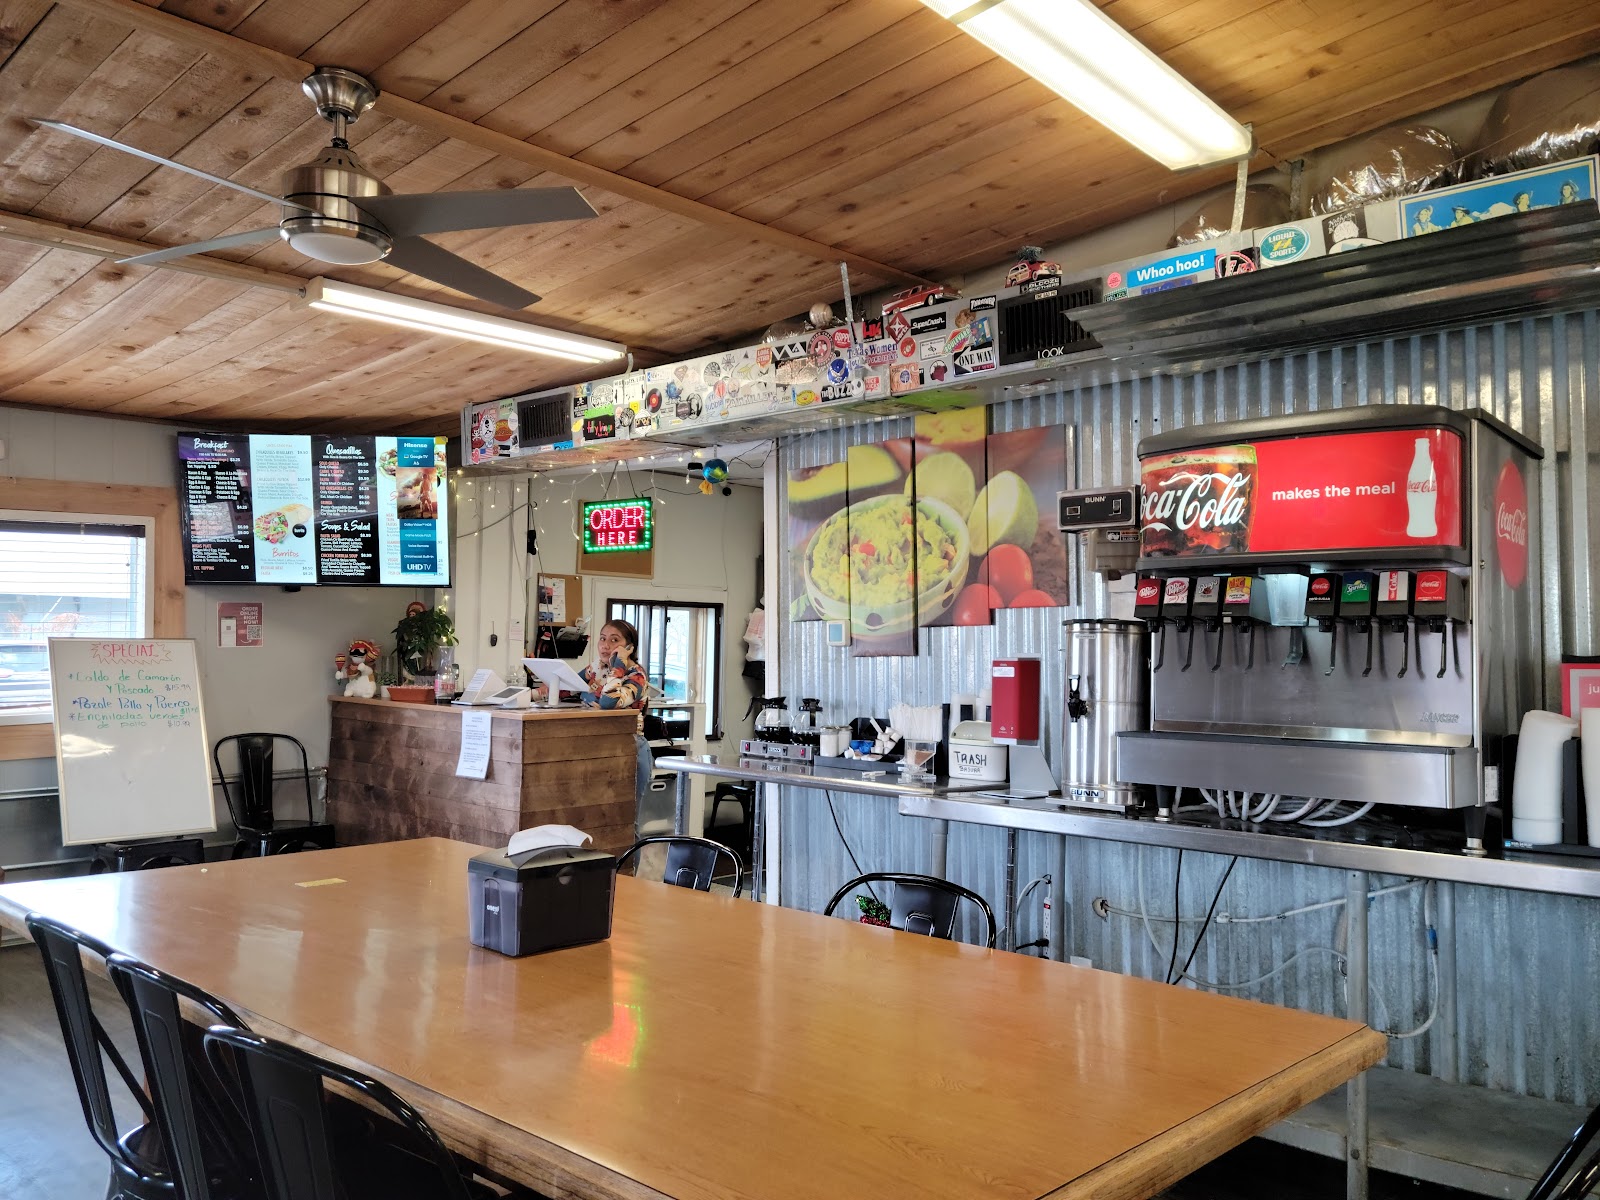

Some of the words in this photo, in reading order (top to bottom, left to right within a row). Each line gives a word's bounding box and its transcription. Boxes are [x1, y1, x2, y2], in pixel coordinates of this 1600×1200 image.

[1268, 231, 1295, 243] LIQUID
[1269, 247, 1297, 259] SPORTS
[1137, 264, 1174, 282] Whoo
[1176, 255, 1205, 272] hoo!
[869, 342, 898, 355] Women
[1037, 346, 1064, 359] LOOK
[959, 354, 975, 367] ONE
[976, 349, 993, 364] WAY
[194, 437, 229, 451] Breakfast
[326, 443, 362, 455] Quesadillas
[1272, 487, 1320, 501] makes
[1324, 484, 1350, 498] the
[1355, 482, 1395, 496] meal
[590, 506, 645, 529] ORDER
[1497, 502, 1526, 546] Coca-Cola
[321, 520, 342, 533] Soups
[343, 522, 350, 531] &
[351, 520, 371, 531] Salad
[597, 531, 636, 546] HERE
[272, 547, 299, 558] Burritos
[1347, 582, 1367, 592] Sprite
[1389, 572, 1398, 591] Coke
[102, 643, 159, 658] SPECIAL
[76, 670, 109, 681] Caldo
[118, 669, 130, 681] de
[115, 683, 154, 694] Pescado
[154, 695, 190, 709] Puerco
[954, 751, 987, 766] TRASH
[1070, 788, 1099, 798] BUNN
